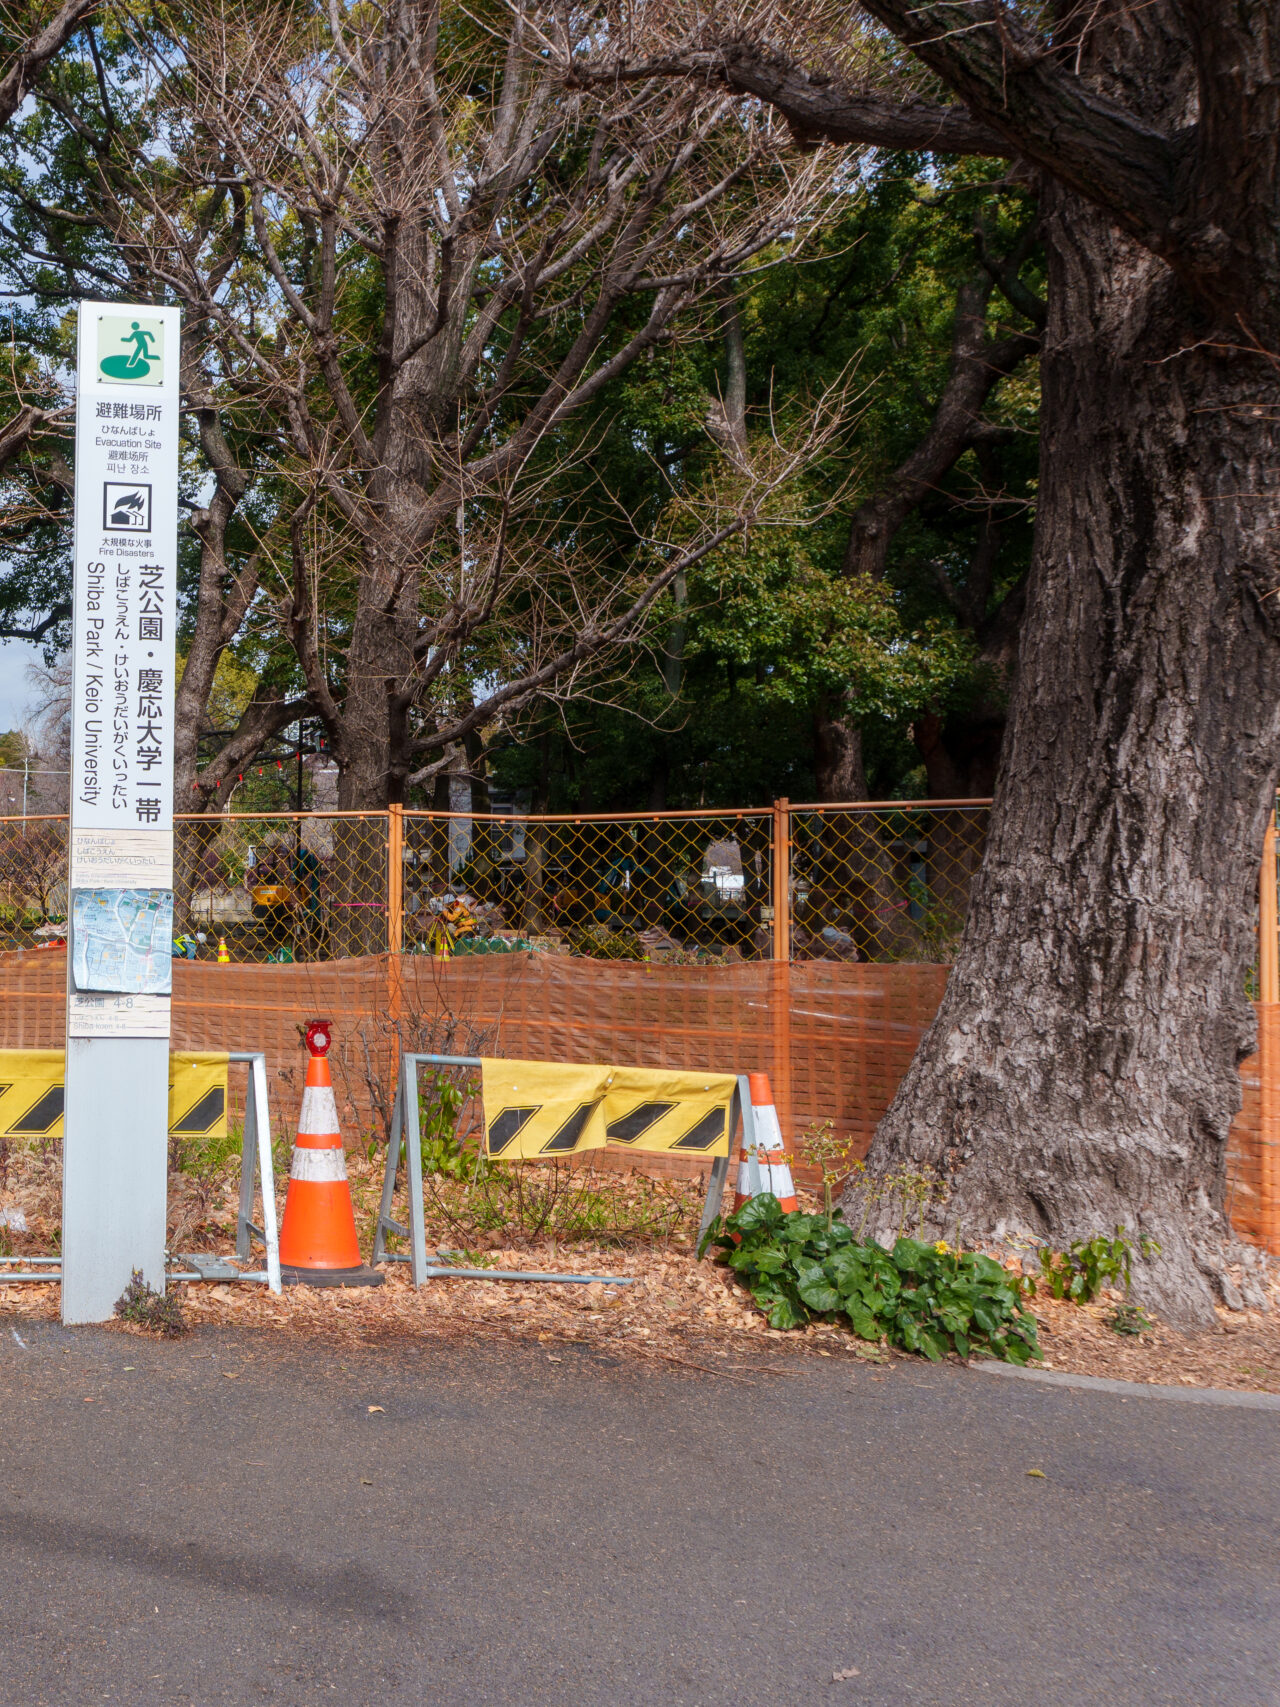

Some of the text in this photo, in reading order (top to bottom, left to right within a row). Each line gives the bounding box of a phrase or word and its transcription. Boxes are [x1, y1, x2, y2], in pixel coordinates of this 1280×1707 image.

[95, 401, 162, 422] 避難場所
[101, 425, 156, 437] ひなんばしょ
[95, 436, 162, 450] Evacuation Site
[108, 450, 149, 462] 避难场所
[106, 463, 150, 475] 피난 장소
[102, 537, 152, 548] 大規模な火事
[99, 547, 155, 558] Fire Disasters
[87, 562, 105, 612] Shiba
[86, 618, 104, 658] Park
[85, 674, 103, 714] Keio
[112, 562, 131, 810] しばこうえん・けいおうだいがくいったい
[135, 564, 165, 824] 芝公園・慶応大学一帯
[79, 720, 103, 806] University
[74, 996, 134, 1009] 芝公園 4-8
